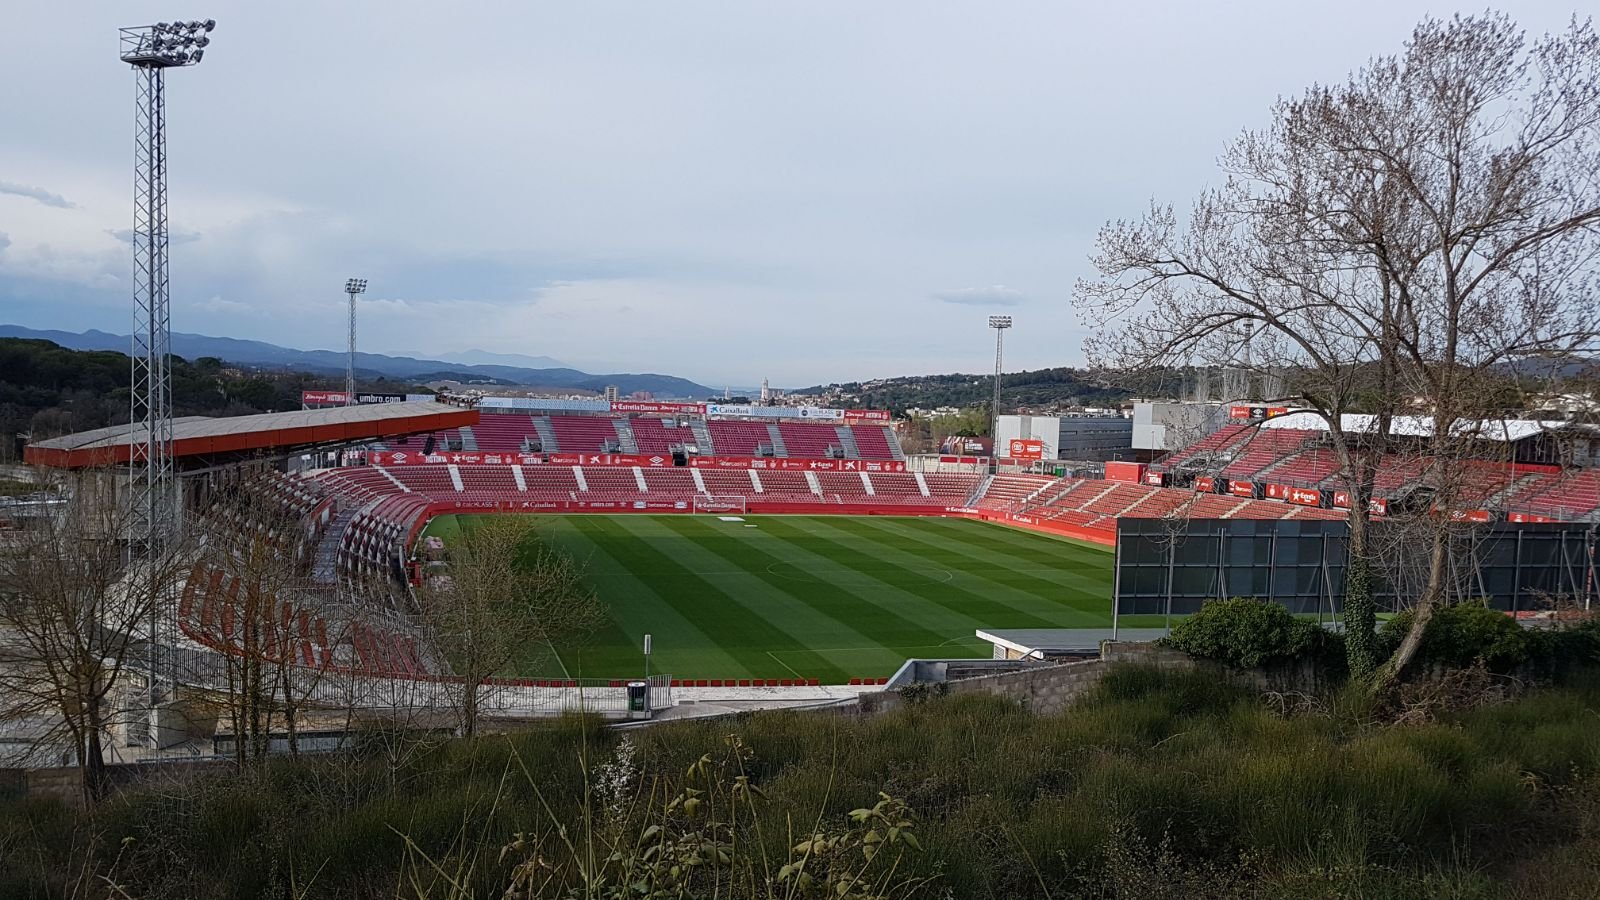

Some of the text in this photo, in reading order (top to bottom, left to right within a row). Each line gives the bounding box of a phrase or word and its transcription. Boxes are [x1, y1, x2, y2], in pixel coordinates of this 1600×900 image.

[359, 395, 401, 403] umbro.com
[618, 403, 640, 411] Estrella
[640, 403, 658, 411] Damm
[719, 406, 749, 415] CaixaBank
